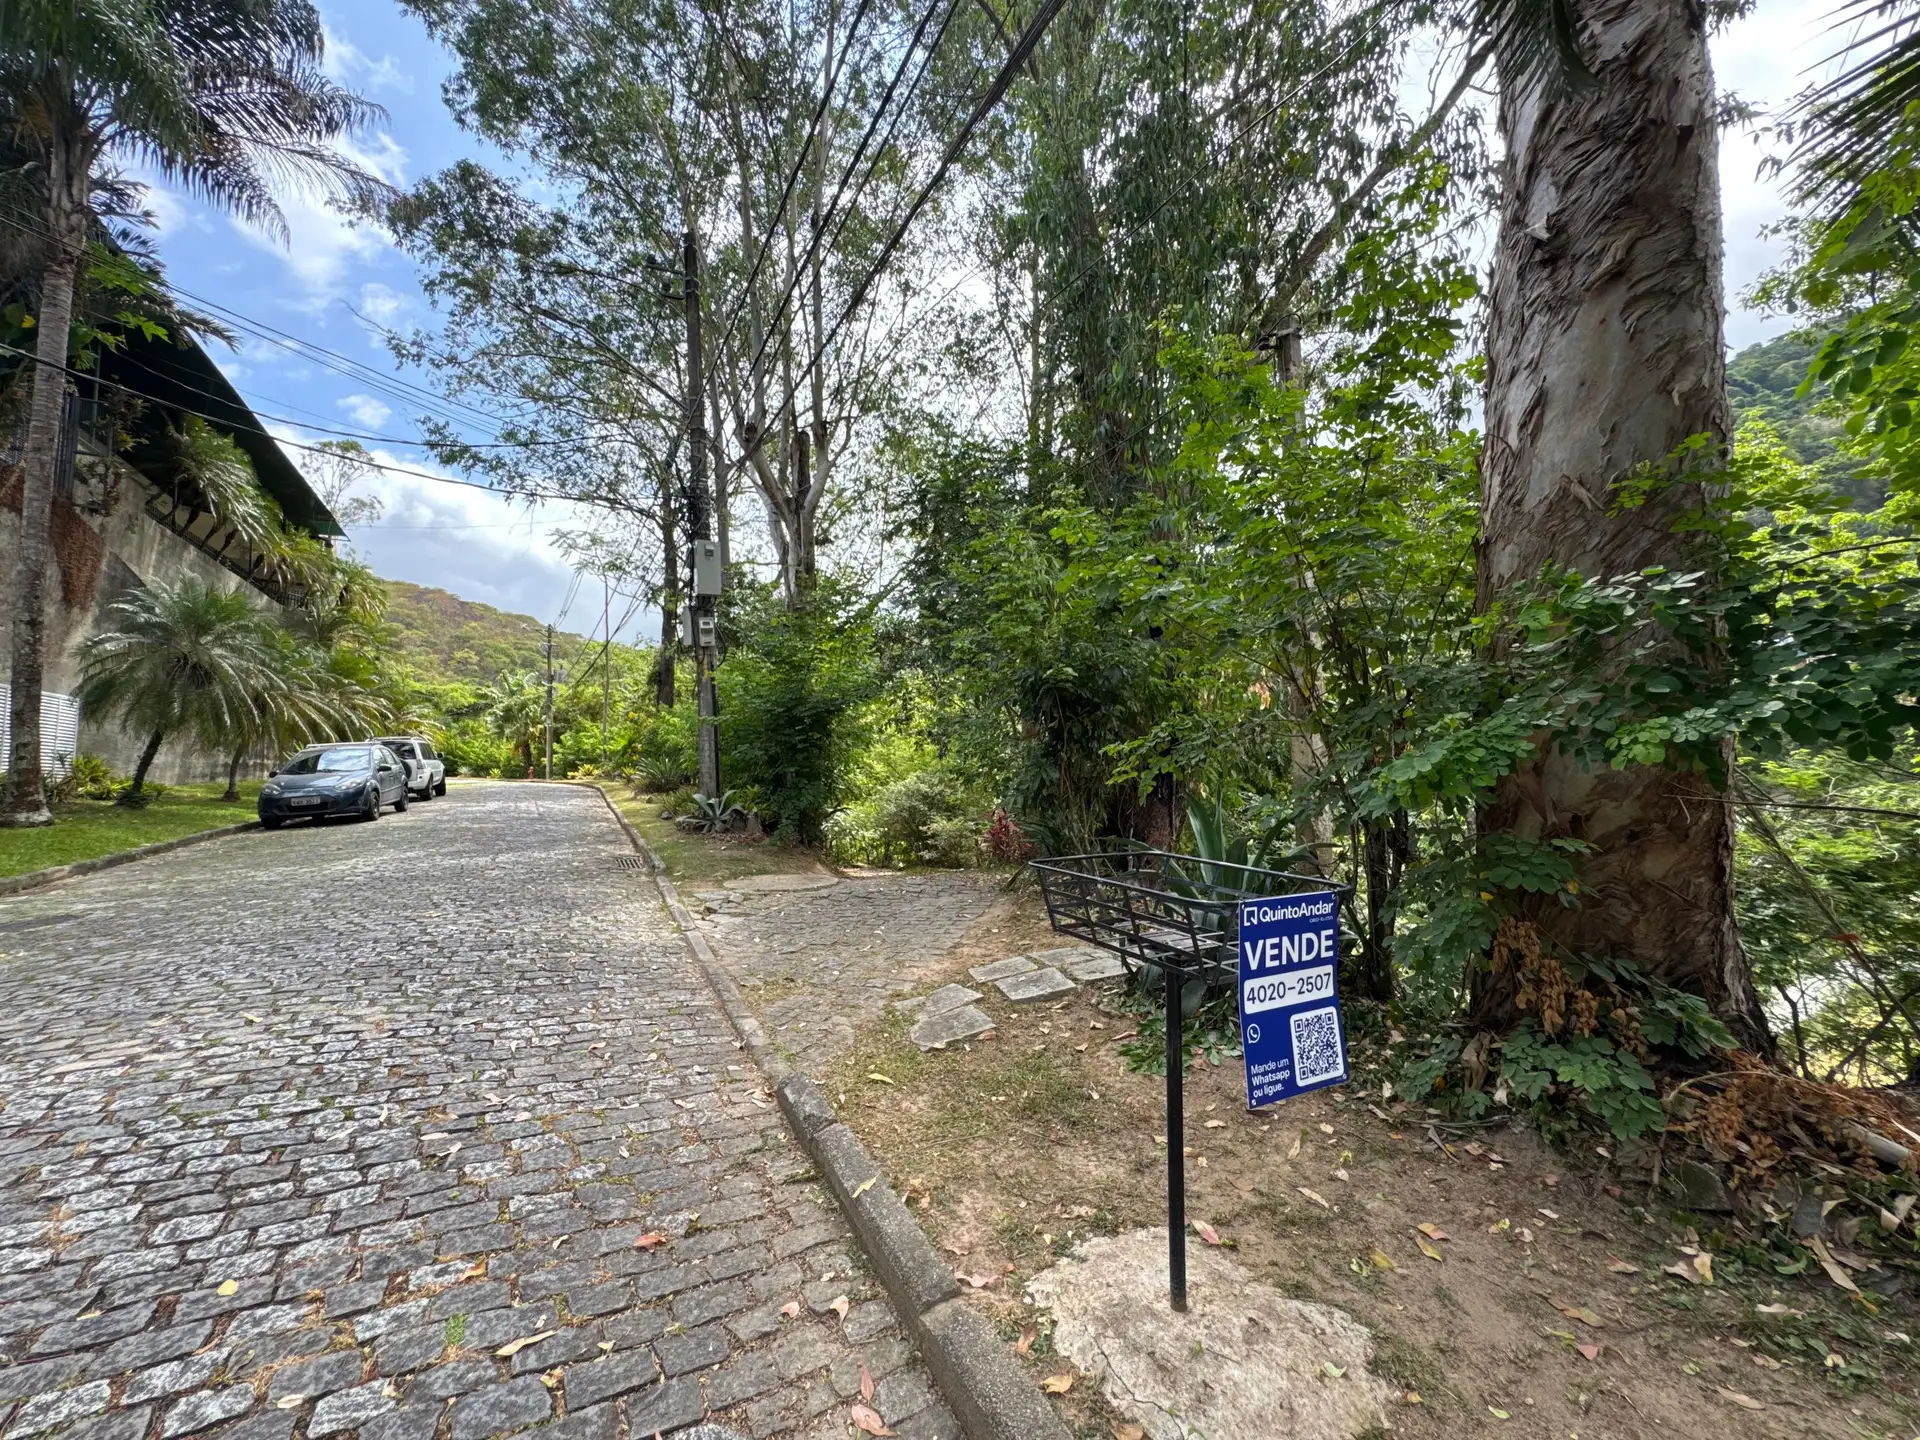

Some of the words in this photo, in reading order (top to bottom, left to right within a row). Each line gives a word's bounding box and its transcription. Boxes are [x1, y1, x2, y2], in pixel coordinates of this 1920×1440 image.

[1259, 900, 1334, 923] QuintoAndar
[1244, 929, 1334, 971] VENDE
[1246, 972, 1332, 1005] 4020-2507
[1251, 1060, 1277, 1075] Mande
[1277, 1058, 1289, 1068] um
[1251, 1069, 1290, 1086] Whatsapp
[1253, 1088, 1263, 1098] ou
[1263, 1083, 1285, 1096] ligue.
